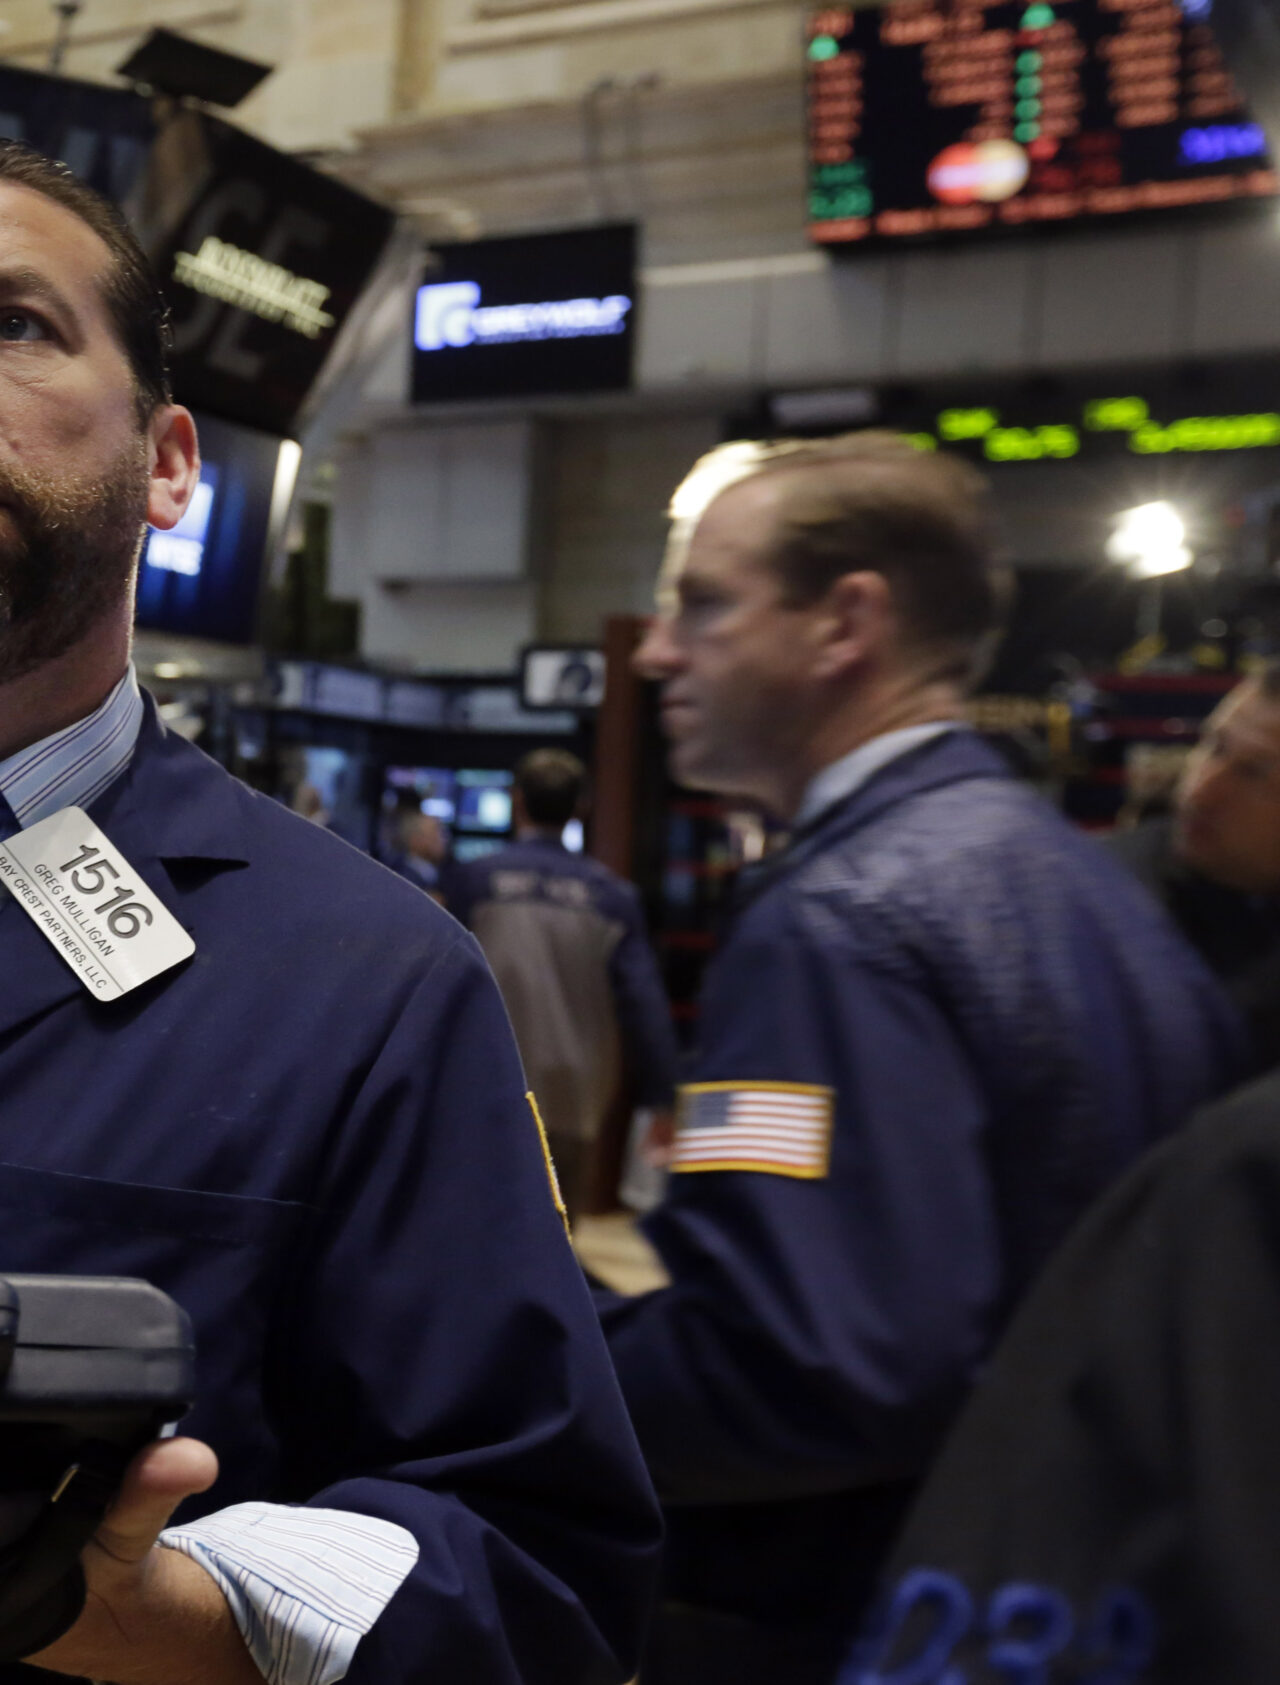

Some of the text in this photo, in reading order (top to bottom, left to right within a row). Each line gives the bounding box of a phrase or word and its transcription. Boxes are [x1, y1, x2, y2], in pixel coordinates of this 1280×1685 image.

[14, 878, 44, 909] CREST
[40, 911, 87, 967] PARTNERS,
[84, 965, 108, 990] LLC
[33, 863, 116, 957] GREG MULLIGAN
[59, 844, 153, 939] 1516
